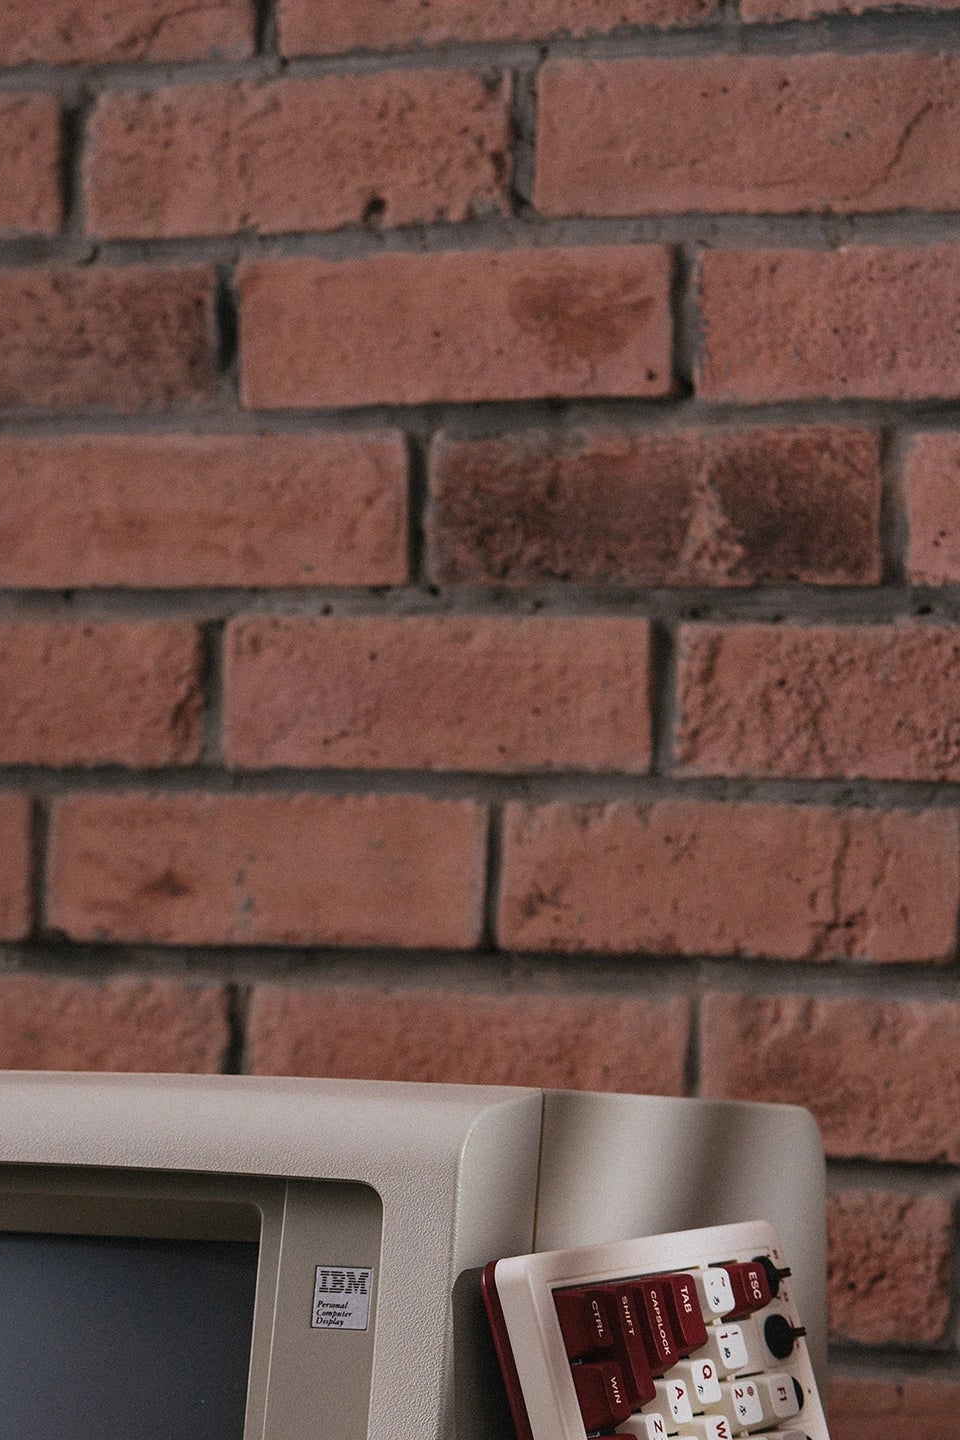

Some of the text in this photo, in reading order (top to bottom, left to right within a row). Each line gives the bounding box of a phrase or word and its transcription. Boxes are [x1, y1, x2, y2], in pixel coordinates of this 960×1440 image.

[319, 1270, 369, 1295] IBM
[747, 1271, 763, 1301] ESC
[316, 1309, 353, 1319] Computer
[317, 1300, 349, 1309] Personal
[680, 1285, 693, 1315] TAB
[315, 1317, 345, 1327] Display
[591, 1300, 604, 1338] CTRL
[621, 1295, 636, 1336] SHIFT
[649, 1290, 673, 1356] CAPSLOCK
[610, 1376, 622, 1405] WIN
[776, 1387, 788, 1402] F1
